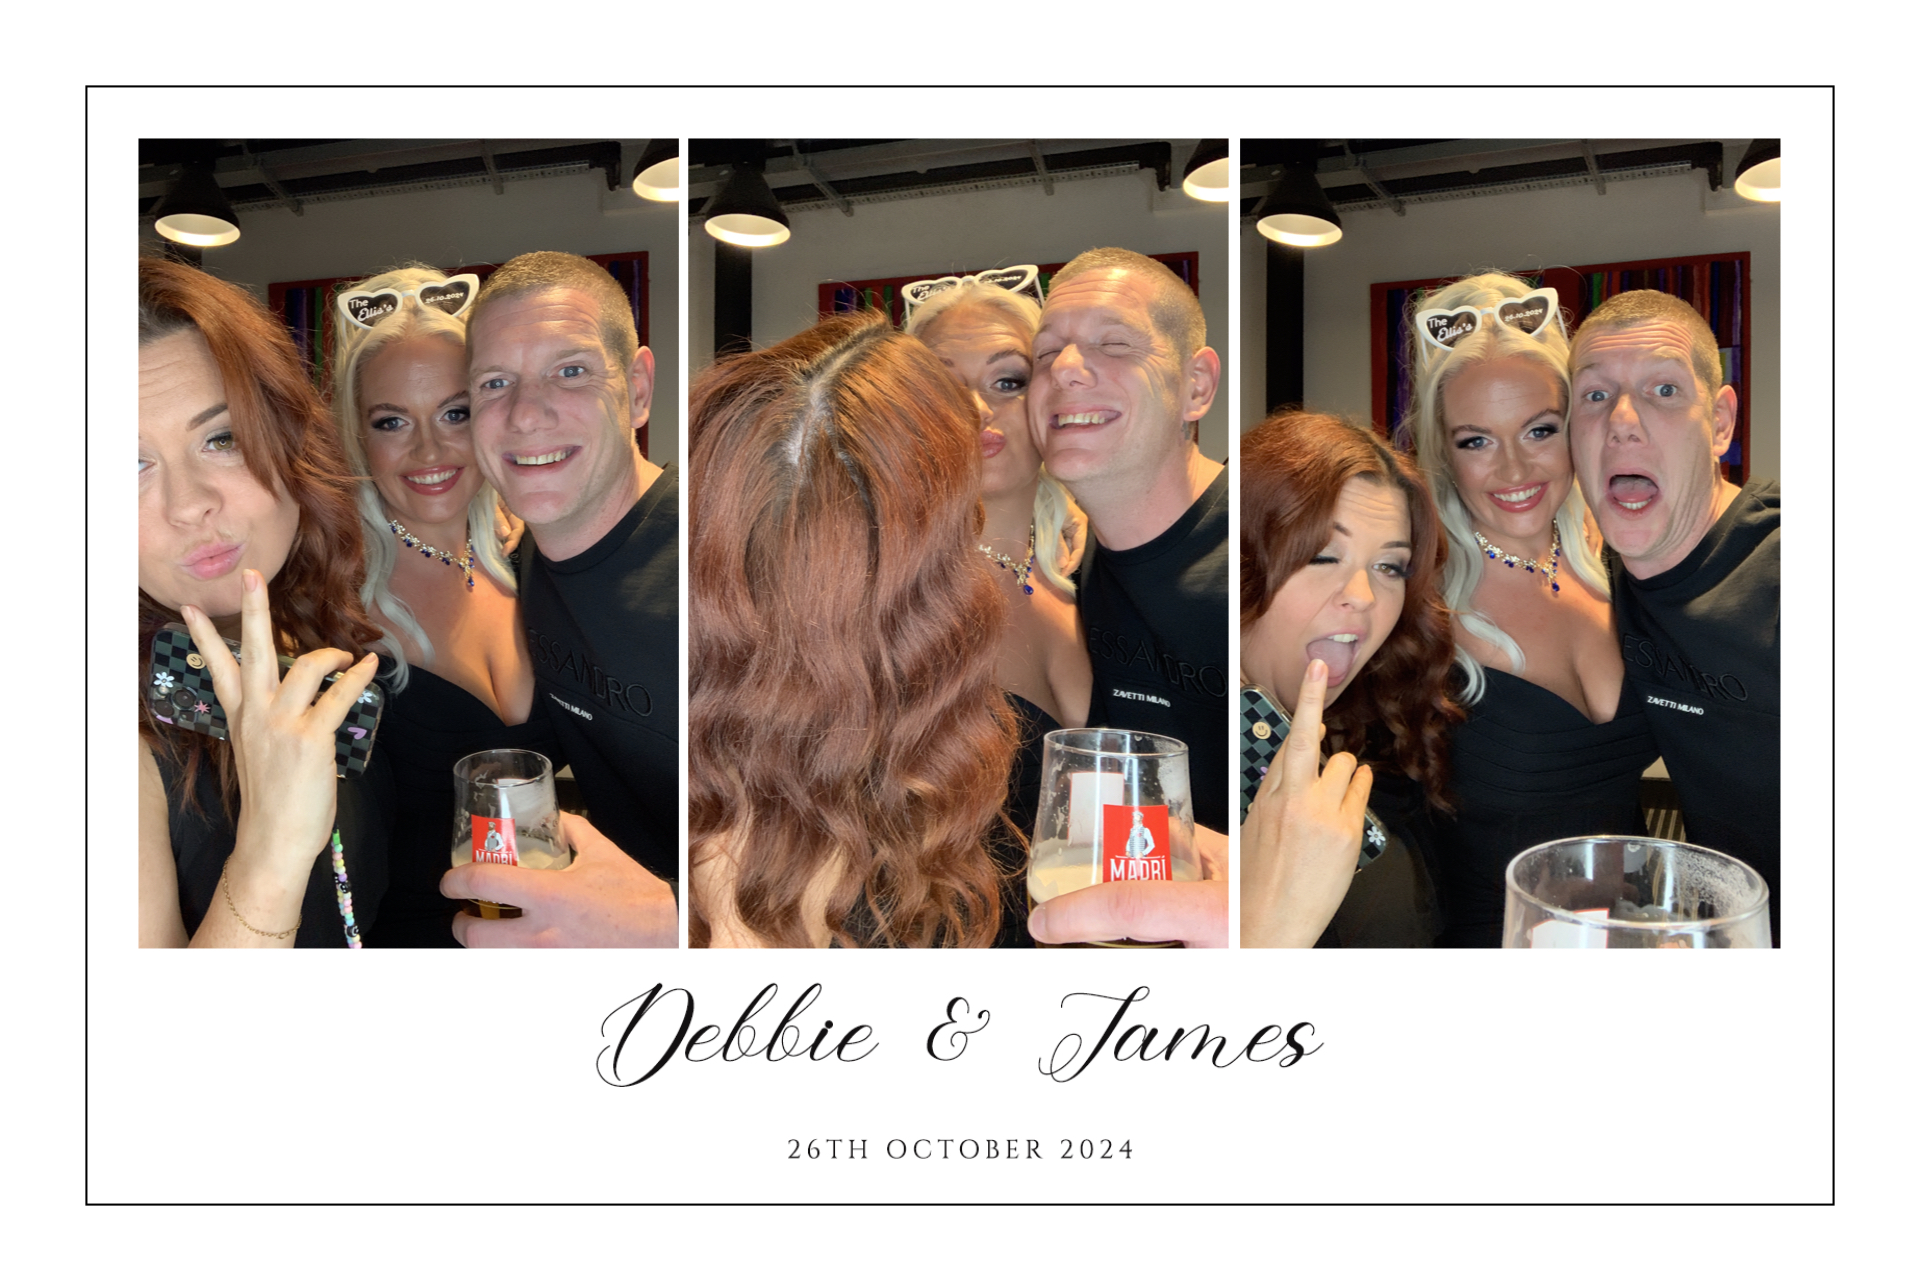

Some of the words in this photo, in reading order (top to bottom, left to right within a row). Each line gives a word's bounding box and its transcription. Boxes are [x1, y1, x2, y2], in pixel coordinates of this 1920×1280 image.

[350, 299, 369, 309] The
[357, 304, 393, 321] Ellis's
[1428, 318, 1448, 329] The
[1437, 323, 1473, 342] Ellis's
[1113, 689, 1145, 702] ZAVETTI
[1146, 695, 1172, 708] MILANO
[1647, 695, 1677, 709] ZAVETTI
[1677, 703, 1704, 716] MILANO
